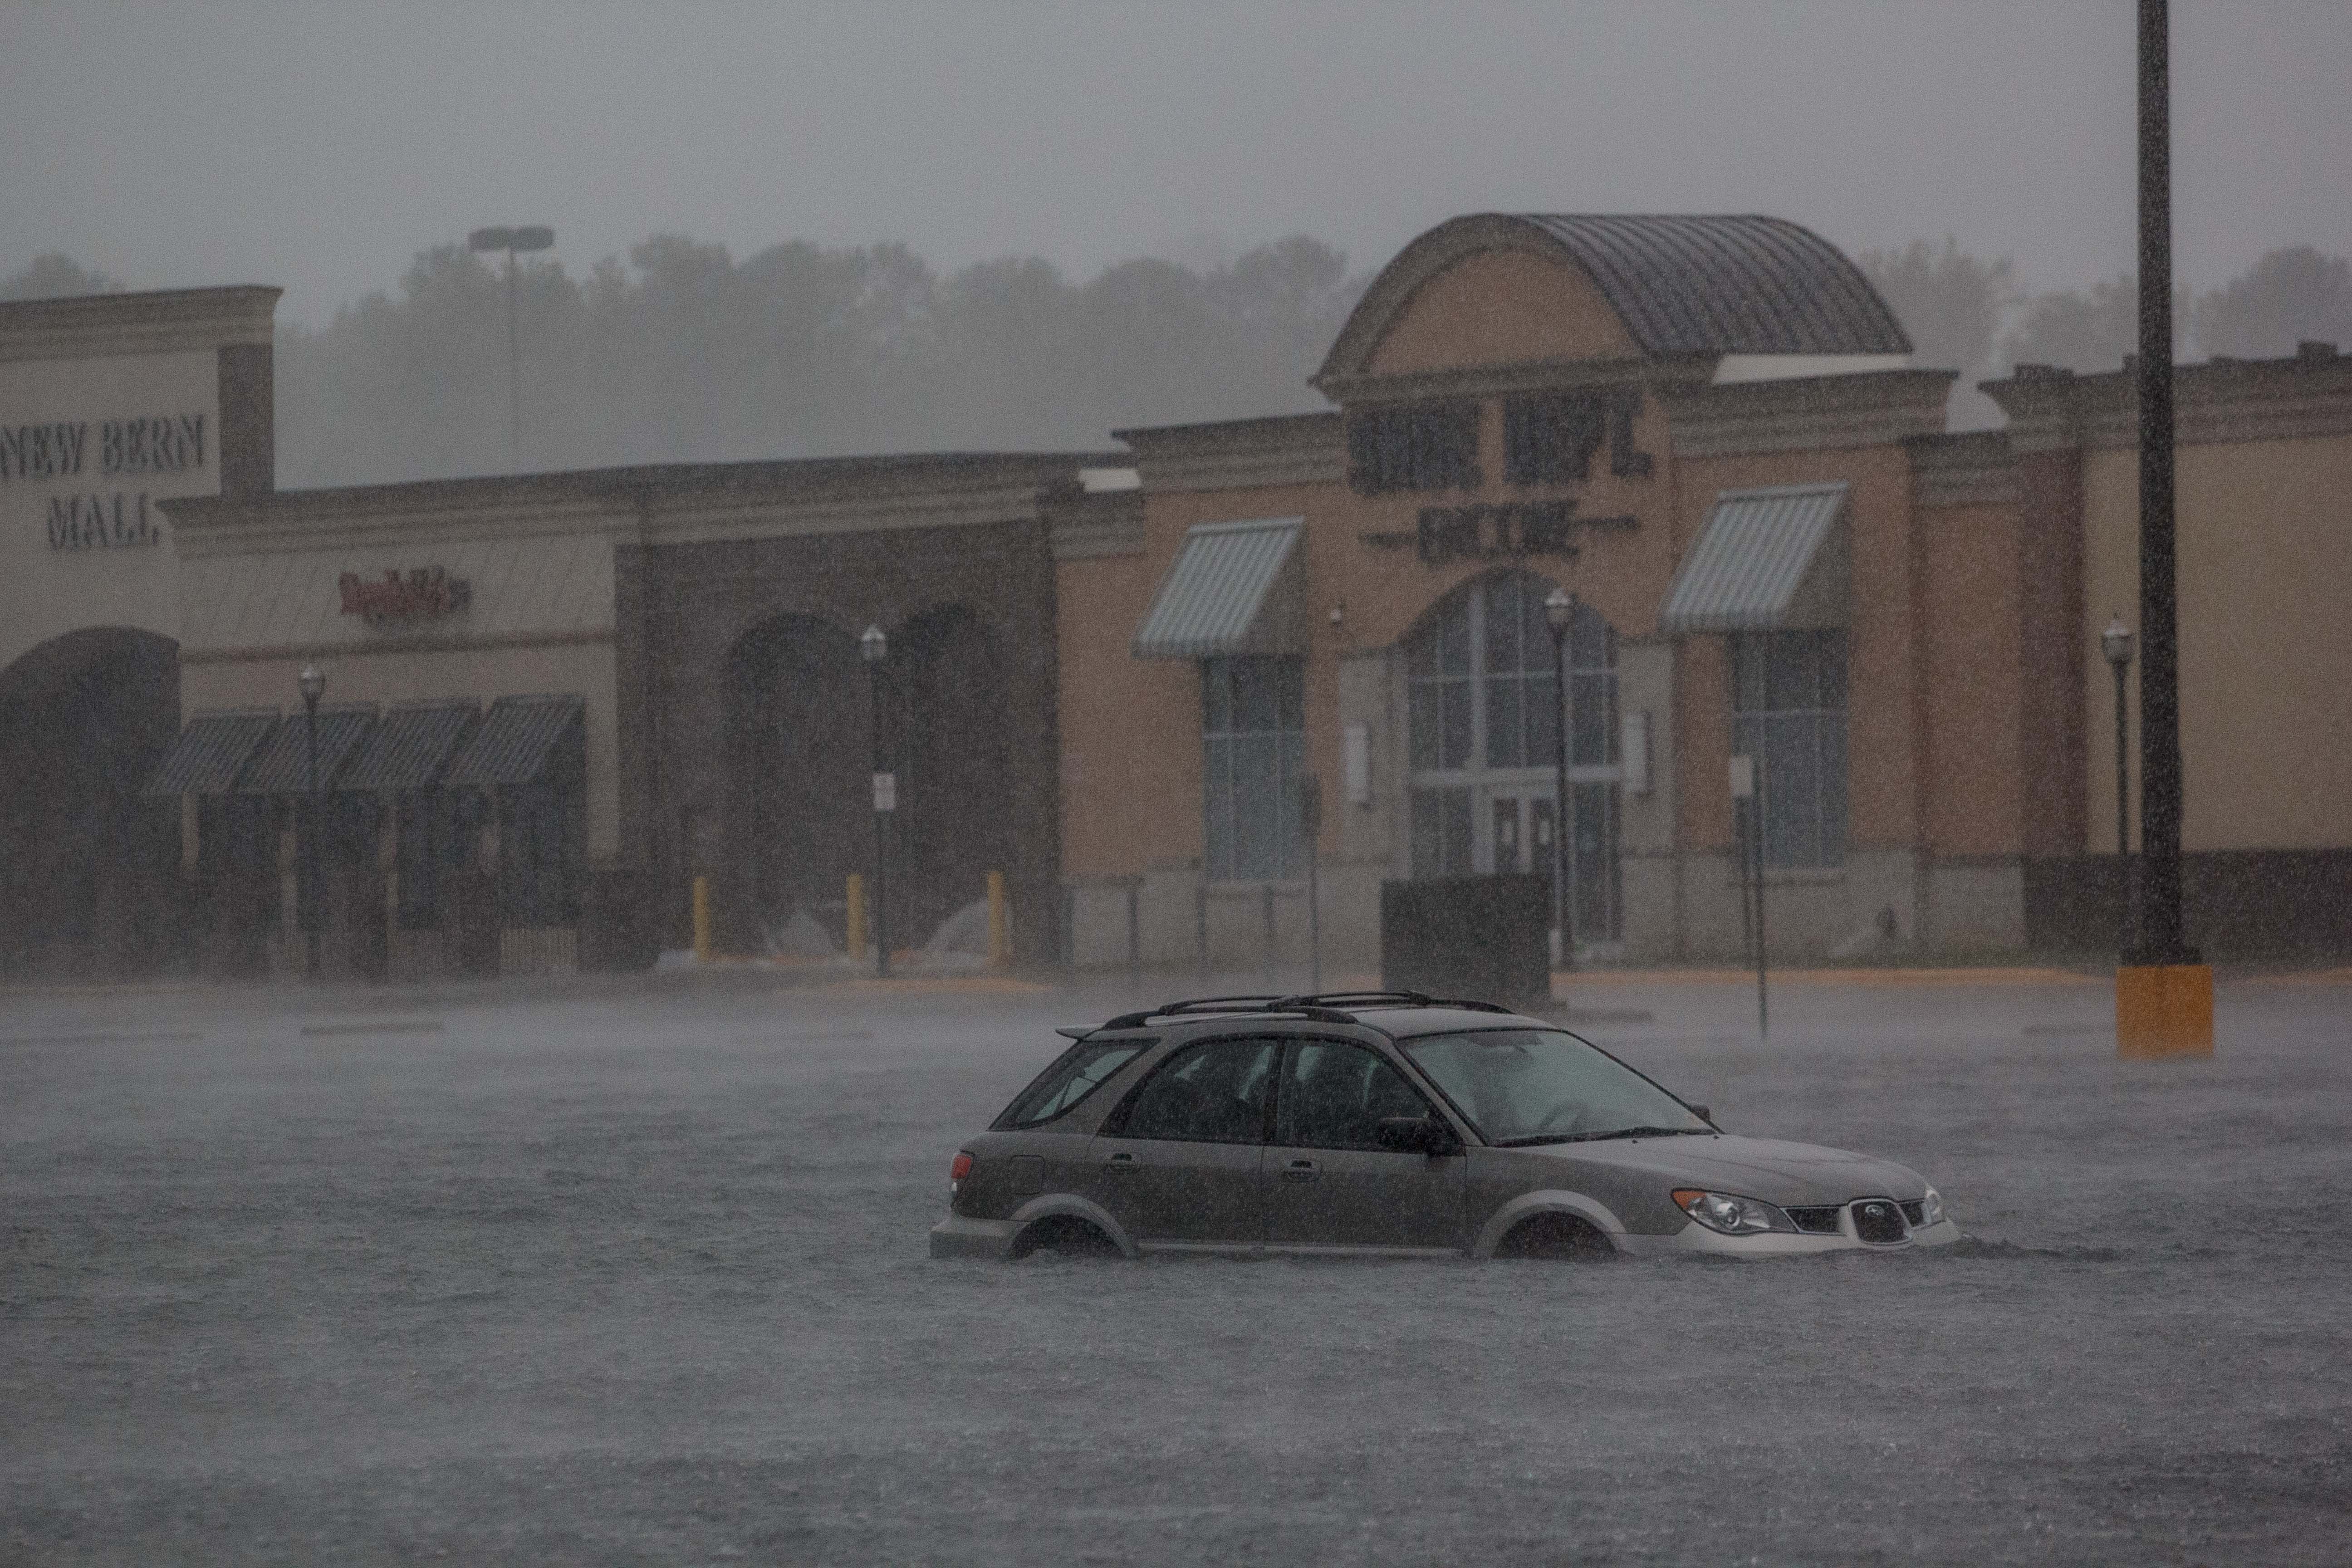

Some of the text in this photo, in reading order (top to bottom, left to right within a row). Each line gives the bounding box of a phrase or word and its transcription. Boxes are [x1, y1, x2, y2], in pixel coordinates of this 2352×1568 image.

[0, 414, 203, 479] NEW BERN
[47, 492, 160, 550] MALL
